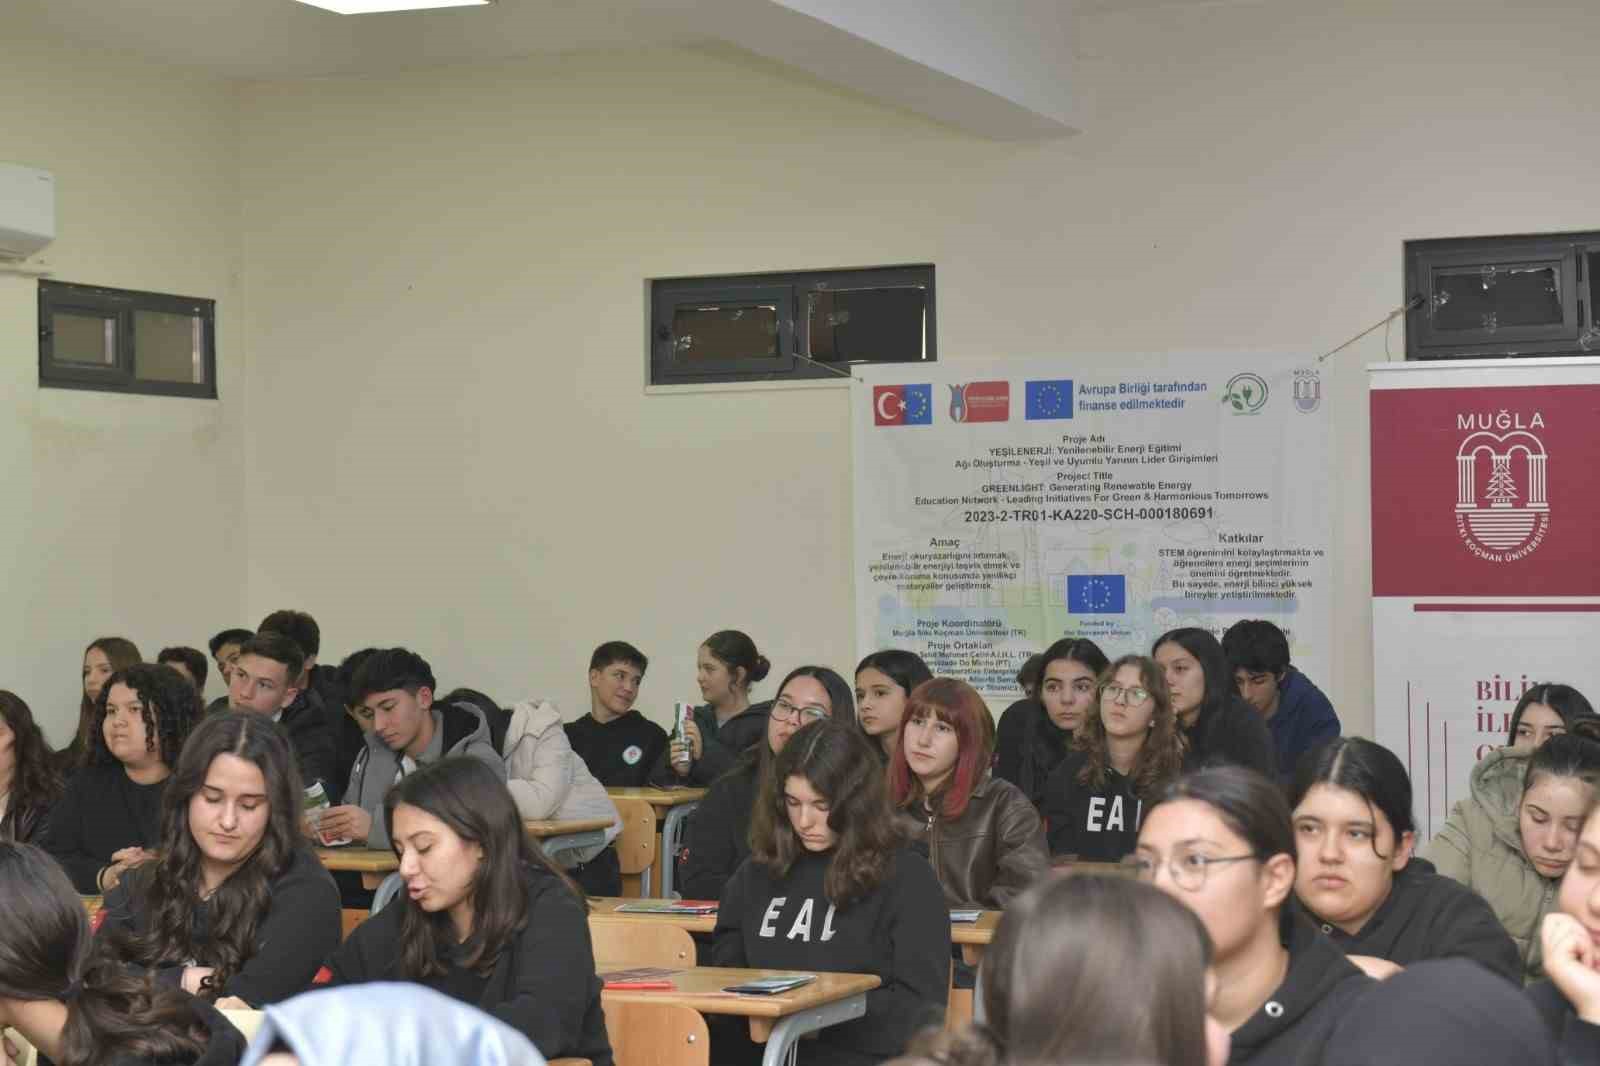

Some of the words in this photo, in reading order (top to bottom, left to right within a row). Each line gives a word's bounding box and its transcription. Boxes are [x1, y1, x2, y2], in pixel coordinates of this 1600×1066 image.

[1079, 383, 1116, 396] Avrupa
[1118, 382, 1151, 396] Birliği
[1153, 380, 1207, 393] tarafından
[1079, 399, 1117, 411] finanse
[1119, 398, 1185, 410] edilmektedir
[1457, 409, 1545, 430] MUĞLA
[1062, 435, 1086, 445] Proje
[1089, 434, 1105, 443] Adı
[1056, 444, 1115, 455] Yenilenebilir
[1117, 443, 1145, 455] Enerji
[1147, 443, 1182, 455] Eğitimi
[1028, 457, 1051, 468] Yeşil
[1053, 459, 1065, 467] ve
[1067, 456, 1103, 467] Uyumlu
[1141, 455, 1166, 464] Lider
[1168, 453, 1218, 465] Girişimleri
[1056, 471, 1091, 482] Project
[1094, 471, 1113, 480] Title
[1049, 482, 1101, 494] Generating
[1103, 481, 1156, 492] Renewable
[1159, 480, 1192, 492] Energy
[914, 495, 959, 506] Education
[1007, 493, 1044, 505] Leading
[1046, 493, 1091, 504] Initiatives
[1094, 492, 1110, 502] For
[1112, 492, 1142, 502] Green
[1144, 491, 1151, 501] &
[1154, 490, 1212, 502] Harmonious
[1215, 490, 1269, 500] Tomorrows
[965, 507, 1214, 523] 2023-2-TR01-KA220-SCH-000180691
[929, 537, 960, 549] Amaç
[1218, 532, 1264, 544] Katkılar
[1465, 538, 1502, 563] KOÇMAN
[1505, 513, 1550, 563] ÜNİVERSİTESİ
[1158, 548, 1185, 558] STEM
[1226, 559, 1252, 569] enerji
[1254, 559, 1309, 569] seçimlerinin
[1172, 579, 1185, 589] Bu
[1224, 580, 1250, 590] enerji
[1252, 579, 1278, 588] bilinci
[1280, 579, 1313, 590] yüksek
[917, 619, 939, 629] Proje
[928, 641, 951, 651] Proje
[1476, 674, 1538, 702] BİLİ
[1086, 794, 1143, 832] EA
